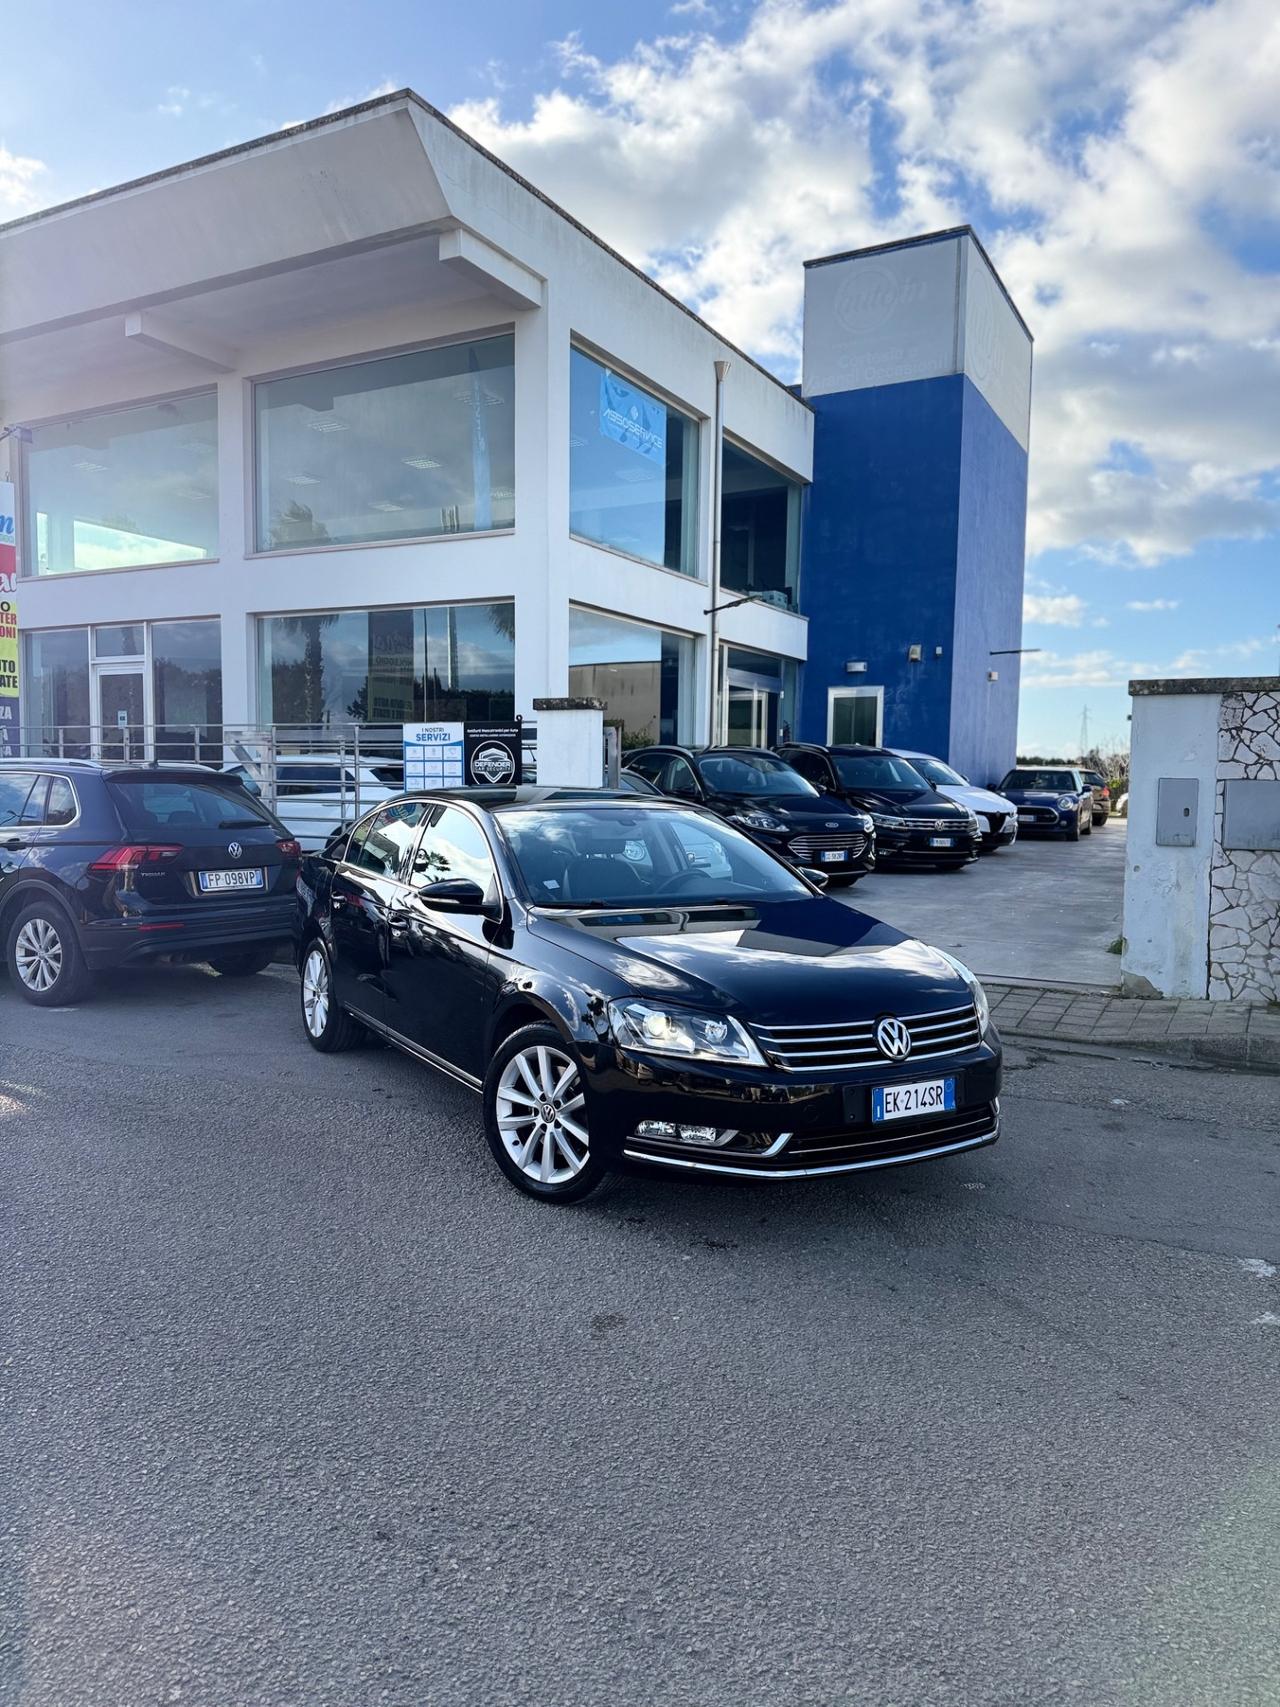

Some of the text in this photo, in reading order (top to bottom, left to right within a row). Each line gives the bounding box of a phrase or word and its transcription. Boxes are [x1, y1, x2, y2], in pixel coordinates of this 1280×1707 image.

[0, 660, 15, 673] TO
[416, 733, 451, 742] SERVIZI
[225, 871, 255, 886] 098VP
[904, 1085, 943, 1110] 214SR
